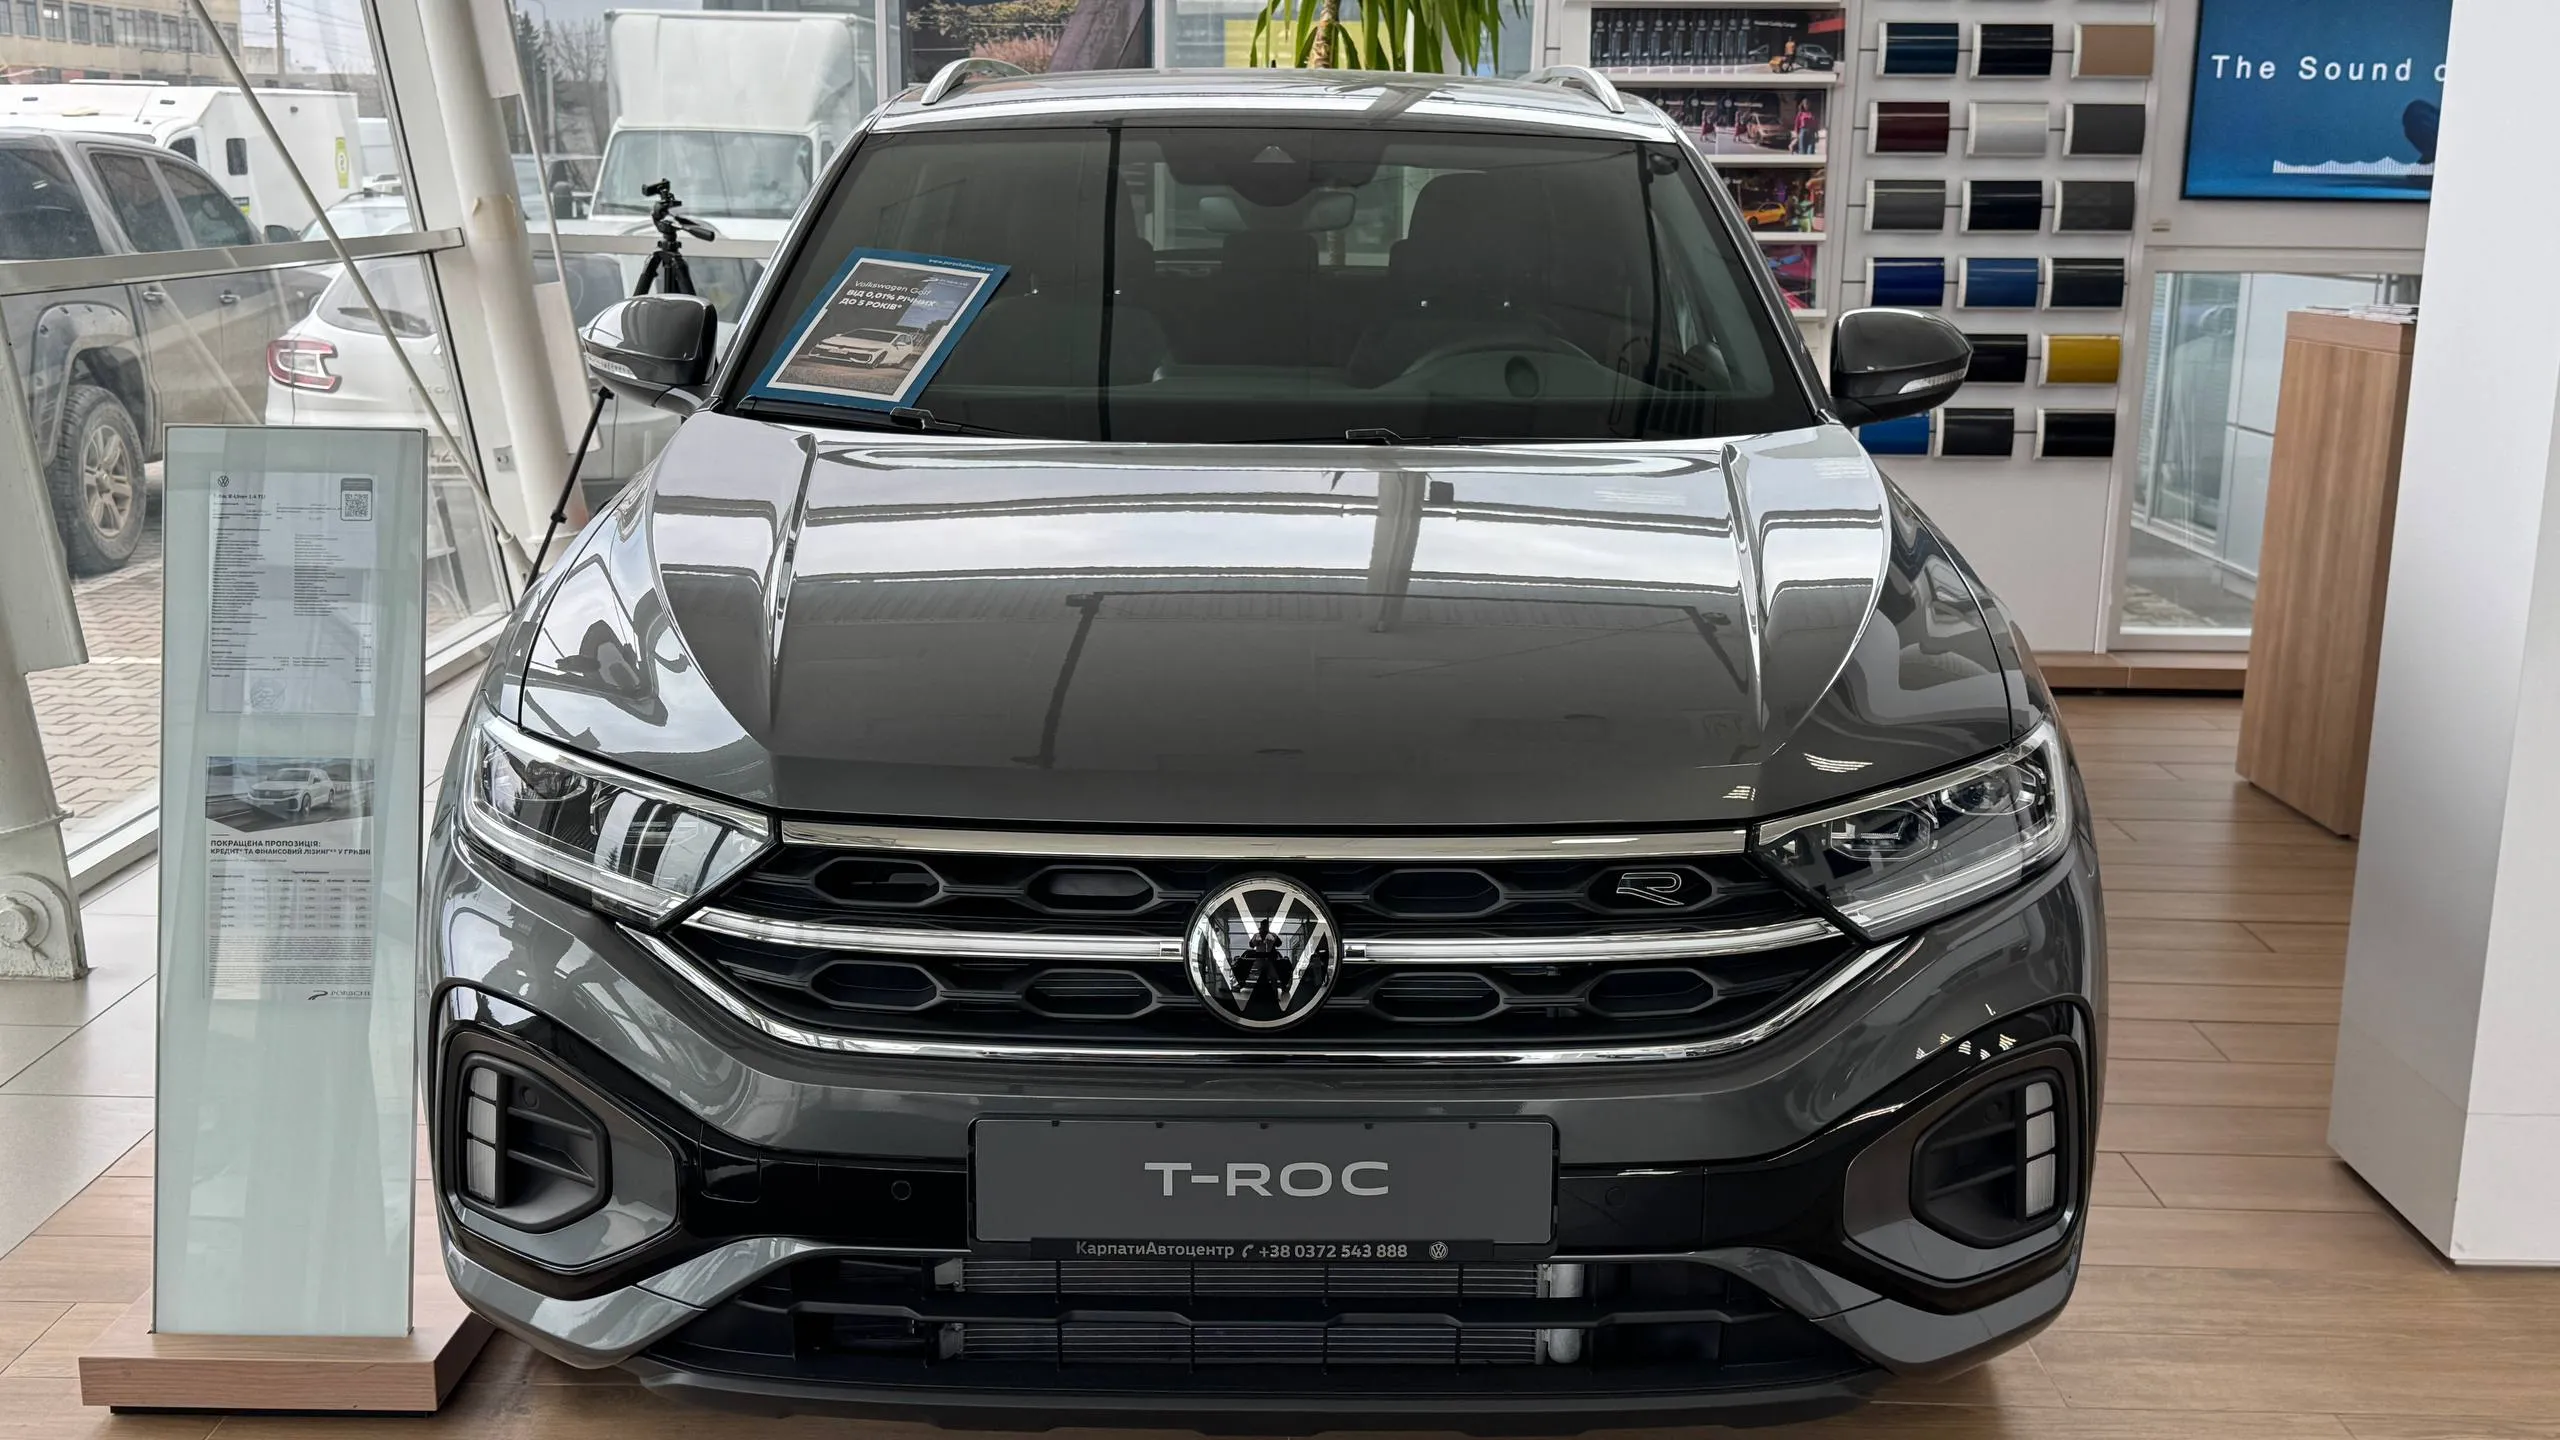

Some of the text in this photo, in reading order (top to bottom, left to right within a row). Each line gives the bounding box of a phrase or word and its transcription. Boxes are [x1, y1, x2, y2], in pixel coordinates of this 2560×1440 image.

[2211, 55, 2276, 79] The
[2298, 55, 2412, 82] Sound
[846, 289, 865, 298] ВІД
[865, 291, 895, 301] 0,01%
[855, 281, 932, 296] Volkswagen Golf
[838, 297, 857, 305] ДО
[210, 840, 321, 848] ПОКРАЩЕНА ПРОПОЗИЦІЯ:
[255, 847, 303, 856] ФІНАНСОВИЙ
[1144, 1161, 1391, 1197] T-ROC
[1076, 1241, 1234, 1258] КарпатиАвтоцентр
[1259, 1245, 1290, 1258] +38
[1294, 1245, 1336, 1258] 0372
[1341, 1245, 1372, 1258] 543
[1376, 1245, 1408, 1258] 888
